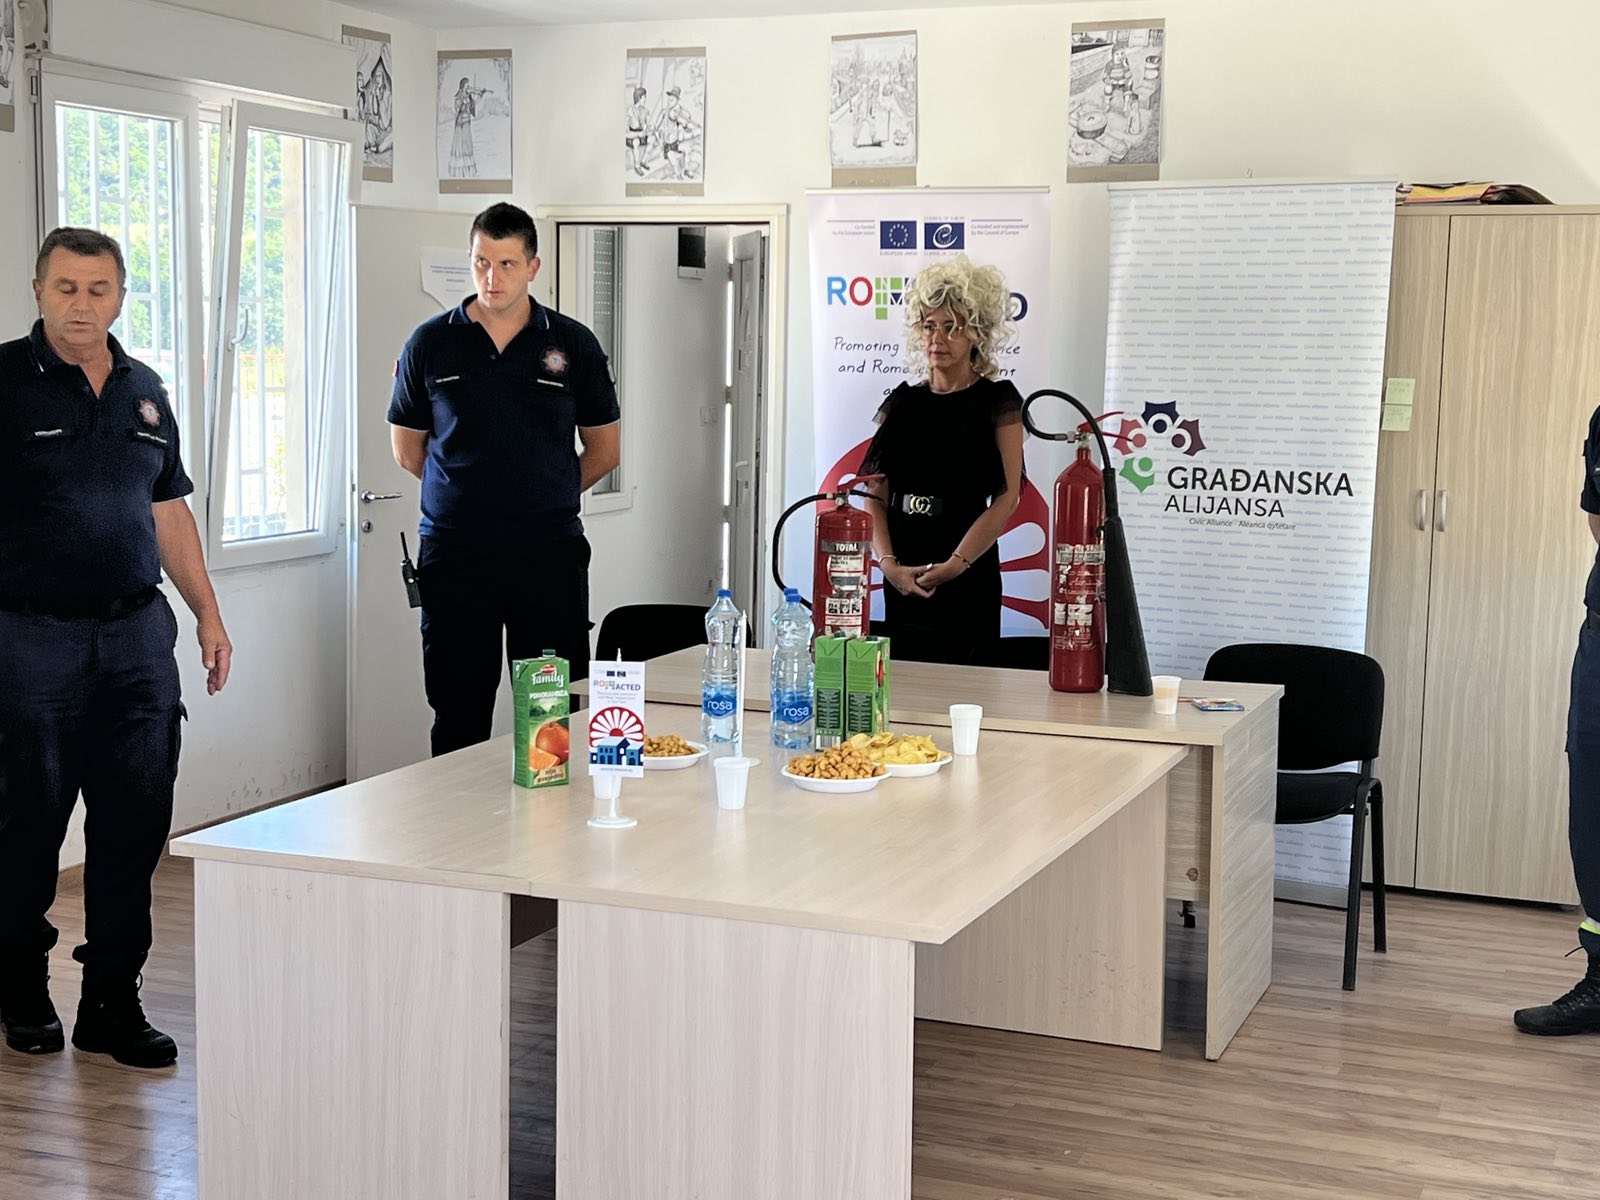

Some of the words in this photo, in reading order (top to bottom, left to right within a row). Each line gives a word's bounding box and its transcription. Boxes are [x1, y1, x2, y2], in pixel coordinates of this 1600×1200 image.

[834, 336, 900, 357] Promoting
[838, 360, 866, 374] and
[1167, 466, 1354, 497] GRAĐANSKA
[1164, 494, 1285, 518] ALIJANSA
[1189, 517, 1205, 525] Civic
[1206, 518, 1233, 527] Alliance
[835, 543, 858, 552] TOTAL
[531, 669, 565, 688] Family
[707, 700, 733, 711] rosa
[783, 707, 809, 717] rosa
